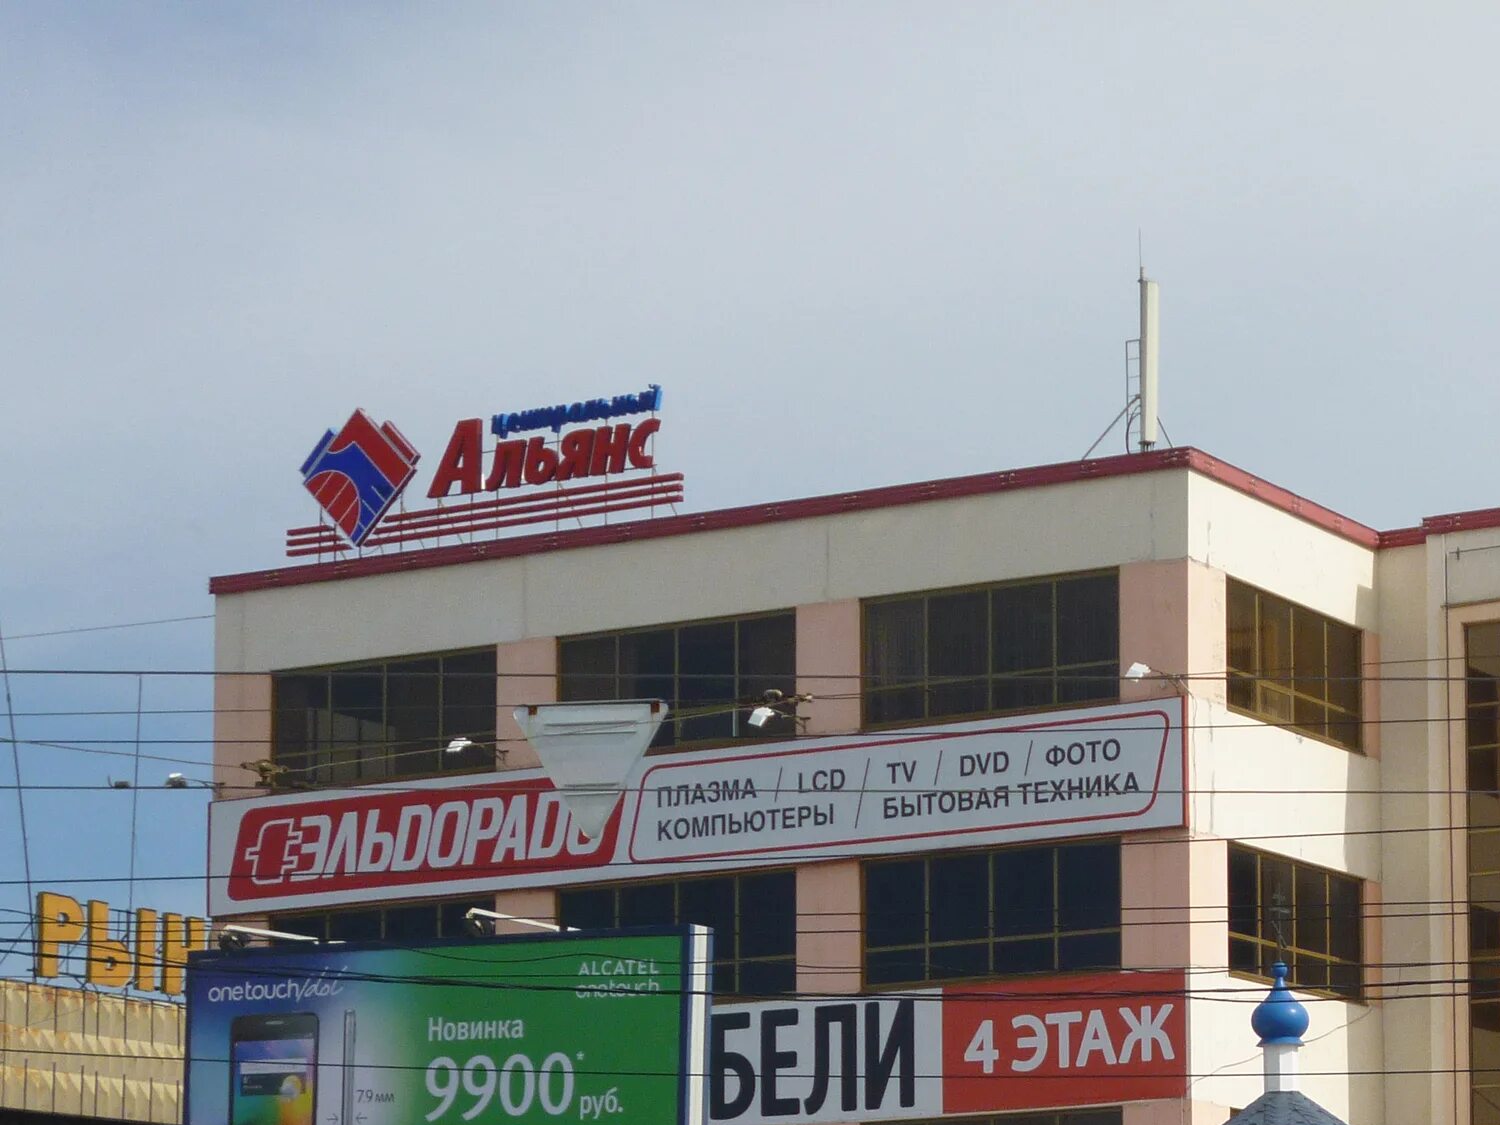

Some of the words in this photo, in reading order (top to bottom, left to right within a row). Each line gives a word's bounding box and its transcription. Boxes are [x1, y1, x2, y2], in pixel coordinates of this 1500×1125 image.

[427, 418, 661, 498] Альянс
[656, 778, 758, 808] ПЛАЗМА
[798, 768, 846, 793] LCD
[886, 760, 917, 785] TV
[959, 750, 1010, 777] DVD
[1045, 738, 1121, 768] ФОТО
[656, 803, 835, 842] КОМПЬЮТЕРЫ
[883, 786, 1010, 820] БЫТОВАЯ
[1017, 772, 1141, 806] ТЕХНИКА
[207, 978, 299, 1003] onetouch
[577, 958, 661, 976] ALCATEL
[427, 1017, 525, 1042] Новинка
[708, 1000, 916, 1121] БЕЛИ
[964, 1019, 999, 1075] 4
[1010, 1004, 1175, 1072] ЭТАЖ
[579, 1087, 624, 1121] руб.
